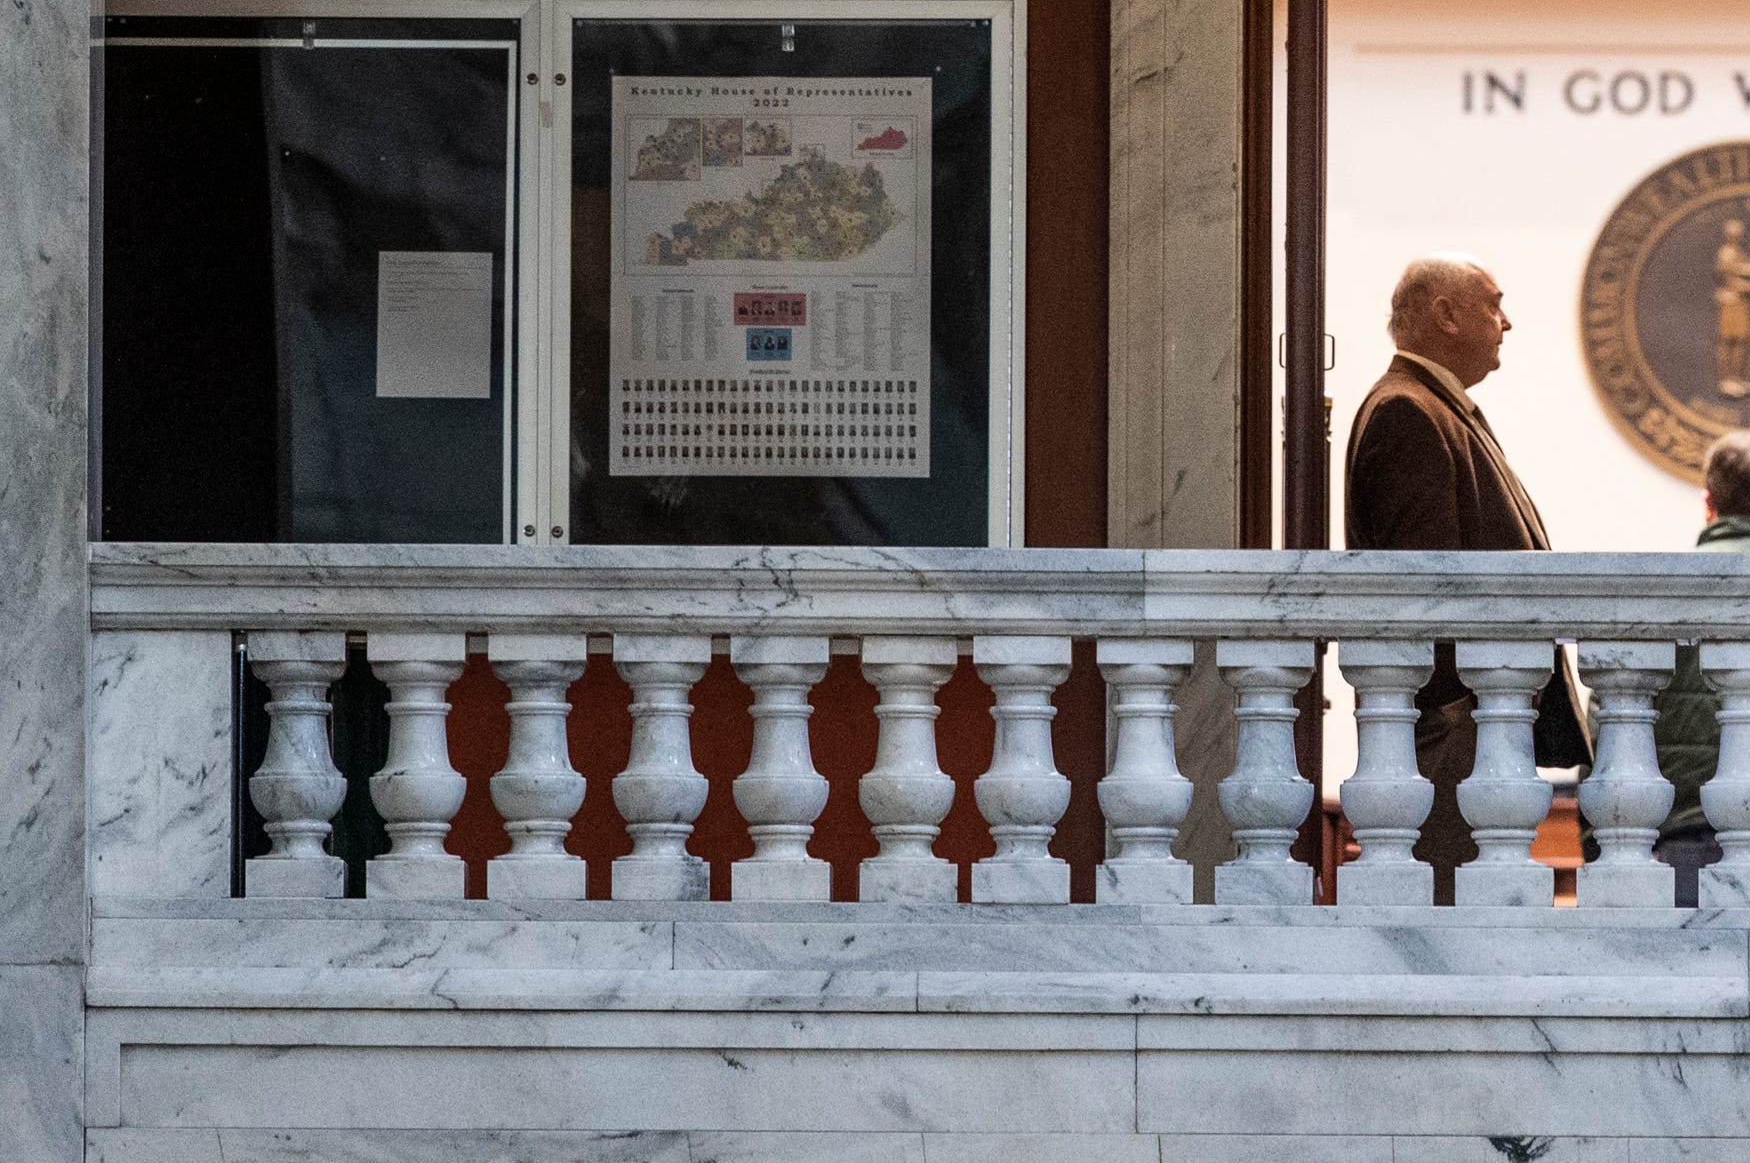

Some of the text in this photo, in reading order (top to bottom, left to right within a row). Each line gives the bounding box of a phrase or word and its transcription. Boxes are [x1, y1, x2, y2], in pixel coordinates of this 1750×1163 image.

[630, 86, 913, 98] Kentucky House of Representatives
[1460, 71, 1527, 116] IN
[1563, 70, 1695, 116] GOD
[752, 98, 789, 107] 2022
